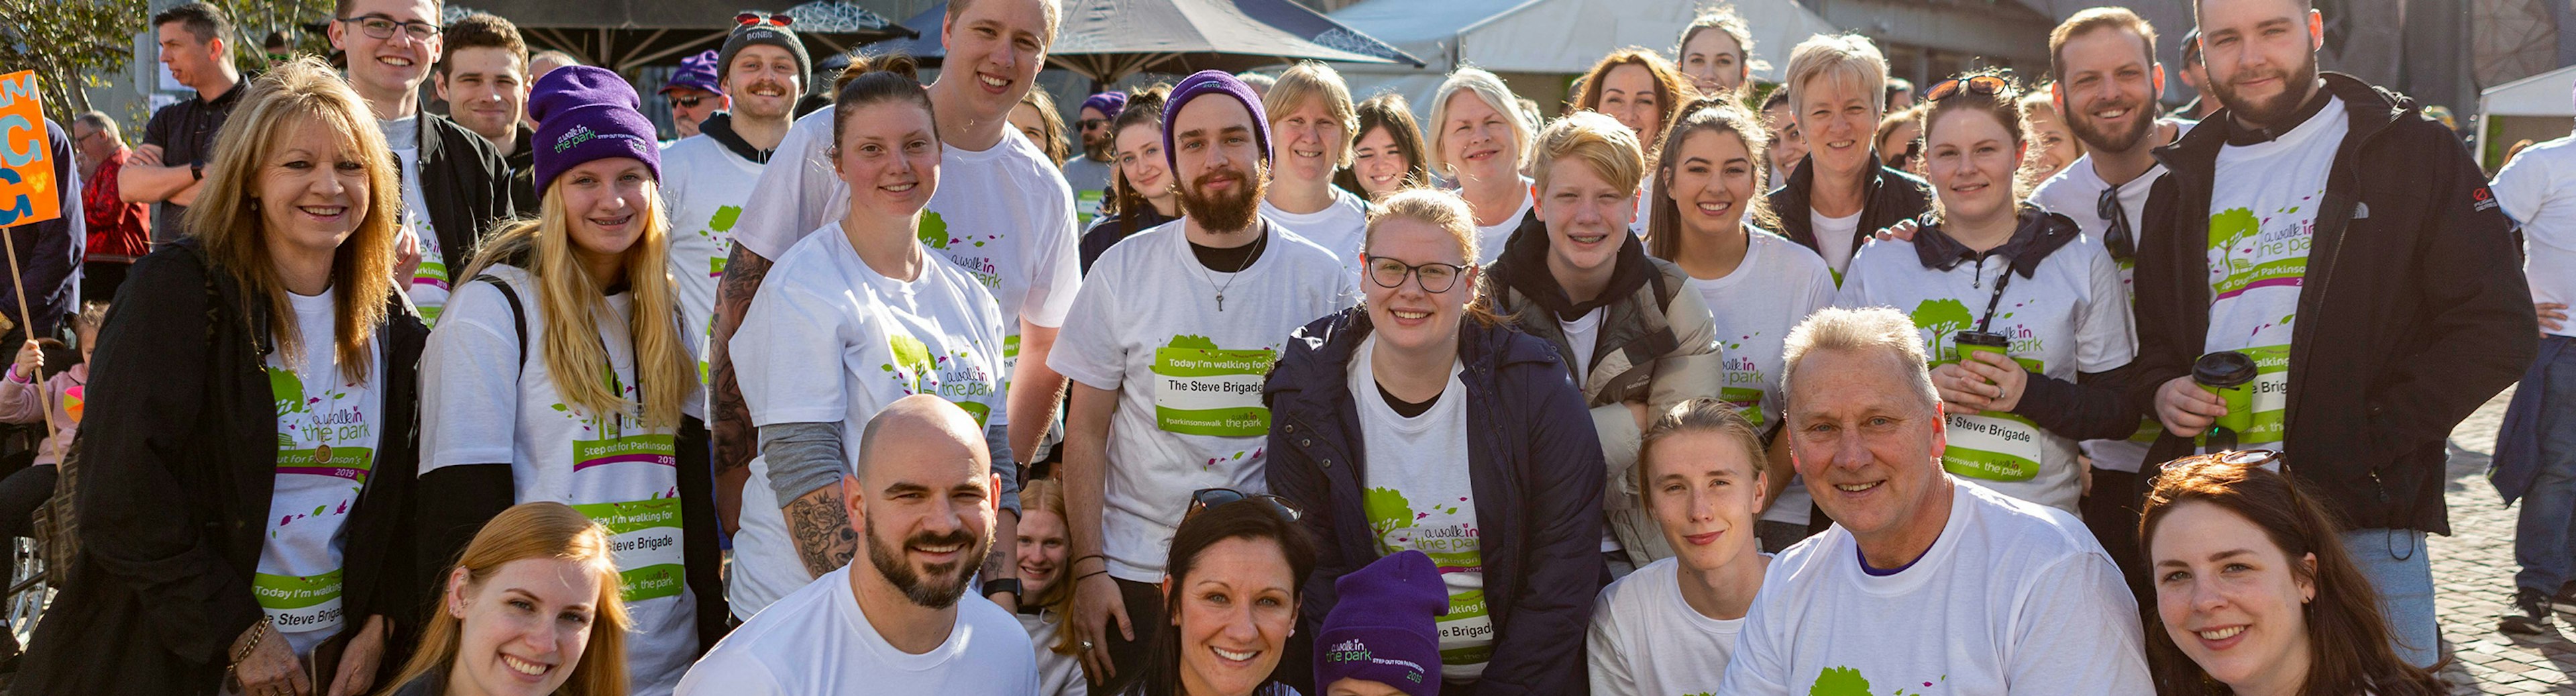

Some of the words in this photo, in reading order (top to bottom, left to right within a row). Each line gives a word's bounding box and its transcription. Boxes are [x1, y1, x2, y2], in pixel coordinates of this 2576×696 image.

[747, 31, 772, 41] BONES
[576, 124, 588, 134] in
[554, 140, 571, 154] the
[572, 129, 596, 148] park
[2264, 232, 2273, 243] a
[2274, 223, 2302, 240] walk
[2288, 236, 2312, 256] pa
[951, 254, 959, 265] a
[960, 256, 982, 271] walk
[983, 257, 995, 275] in
[2261, 265, 2306, 277] Parkinso
[436, 279, 447, 290] 2019
[2017, 324, 2032, 338] in
[1169, 358, 1195, 369] Today
[1197, 360, 1212, 368] I'm
[1214, 360, 1250, 370] walking
[1252, 360, 1265, 368] for
[1743, 357, 1754, 371] in
[947, 372, 955, 383] a
[956, 367, 978, 383] walk
[975, 366, 987, 382] in
[1729, 370, 1764, 385] park
[942, 381, 967, 397] the
[967, 381, 994, 399] park
[1169, 380, 1187, 391] The
[1191, 381, 1220, 392] Steve
[1223, 381, 1263, 395] Brigade
[2261, 381, 2288, 394] Brig
[313, 414, 321, 425] a
[323, 409, 352, 425] walk
[352, 406, 362, 423] in
[1166, 417, 1222, 428] #parkinsonswalk
[1226, 418, 1240, 428] the
[1242, 418, 1262, 429] park
[1955, 416, 1986, 433] Steve
[1989, 424, 2031, 442] Brigade
[302, 425, 333, 442] the
[339, 419, 371, 445] park
[584, 445, 606, 456] Step
[607, 444, 617, 453] out
[618, 442, 629, 452] for
[290, 454, 305, 463] for
[657, 456, 676, 465] 2019
[335, 469, 354, 478] 2019
[1984, 462, 2000, 473] the
[2002, 466, 2023, 477] park
[612, 515, 627, 524] I'm
[628, 511, 660, 524] walking
[662, 511, 673, 519] for
[1425, 529, 1435, 538] a
[1436, 526, 1464, 538] walk
[1462, 523, 1479, 538] in
[638, 535, 673, 550] Brigade
[1414, 538, 1446, 550] the
[641, 579, 655, 590] the
[656, 575, 673, 590] park
[254, 586, 292, 599] Today
[294, 589, 311, 598] I'm
[313, 582, 342, 597] walking
[278, 613, 315, 626] Steve
[1331, 644, 1336, 652] a
[1336, 640, 1354, 651] walk
[1354, 638, 1364, 650] in
[1326, 650, 1342, 662] the
[1345, 648, 1372, 664] park
[1407, 670, 1422, 683] 2019
